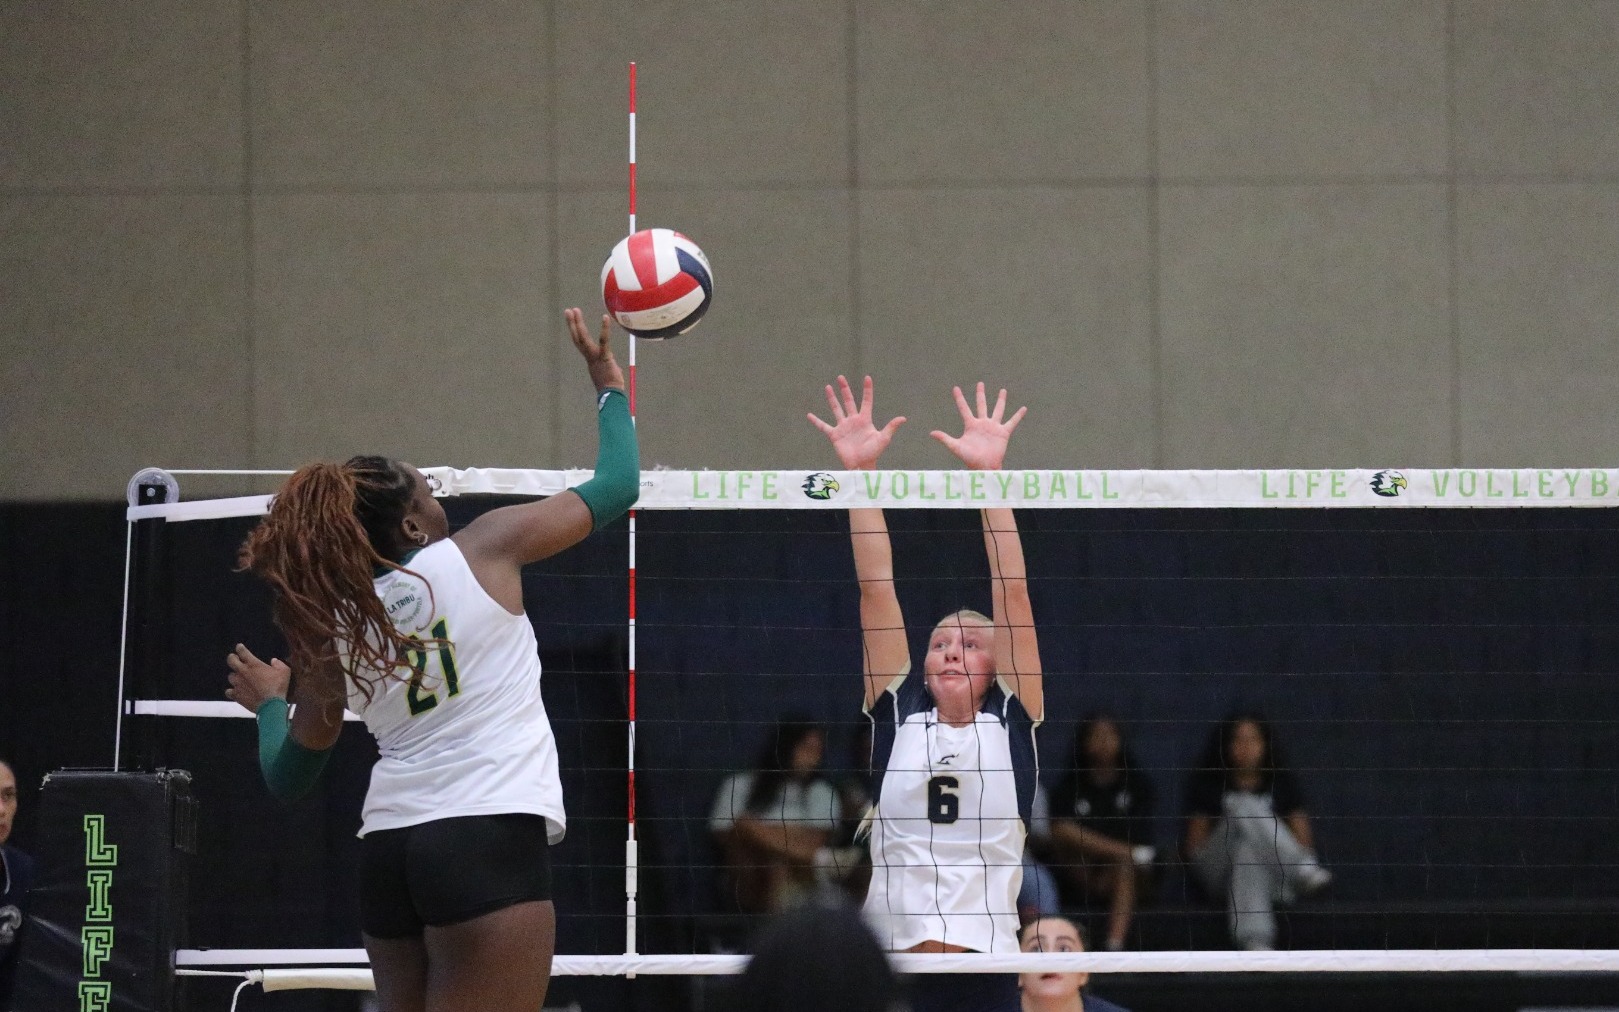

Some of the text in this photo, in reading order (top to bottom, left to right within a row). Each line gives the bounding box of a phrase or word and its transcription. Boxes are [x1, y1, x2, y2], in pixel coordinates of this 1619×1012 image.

[639, 480, 654, 488] orts
[692, 470, 1120, 500] LIFE VOLLEYBALL
[1260, 469, 1619, 499] LIFE VOLLEYB
[387, 604, 397, 614] LA
[395, 593, 415, 609] TRIBU
[399, 617, 461, 717] 21
[927, 775, 959, 825] 6
[78, 814, 118, 1012] LIFE
